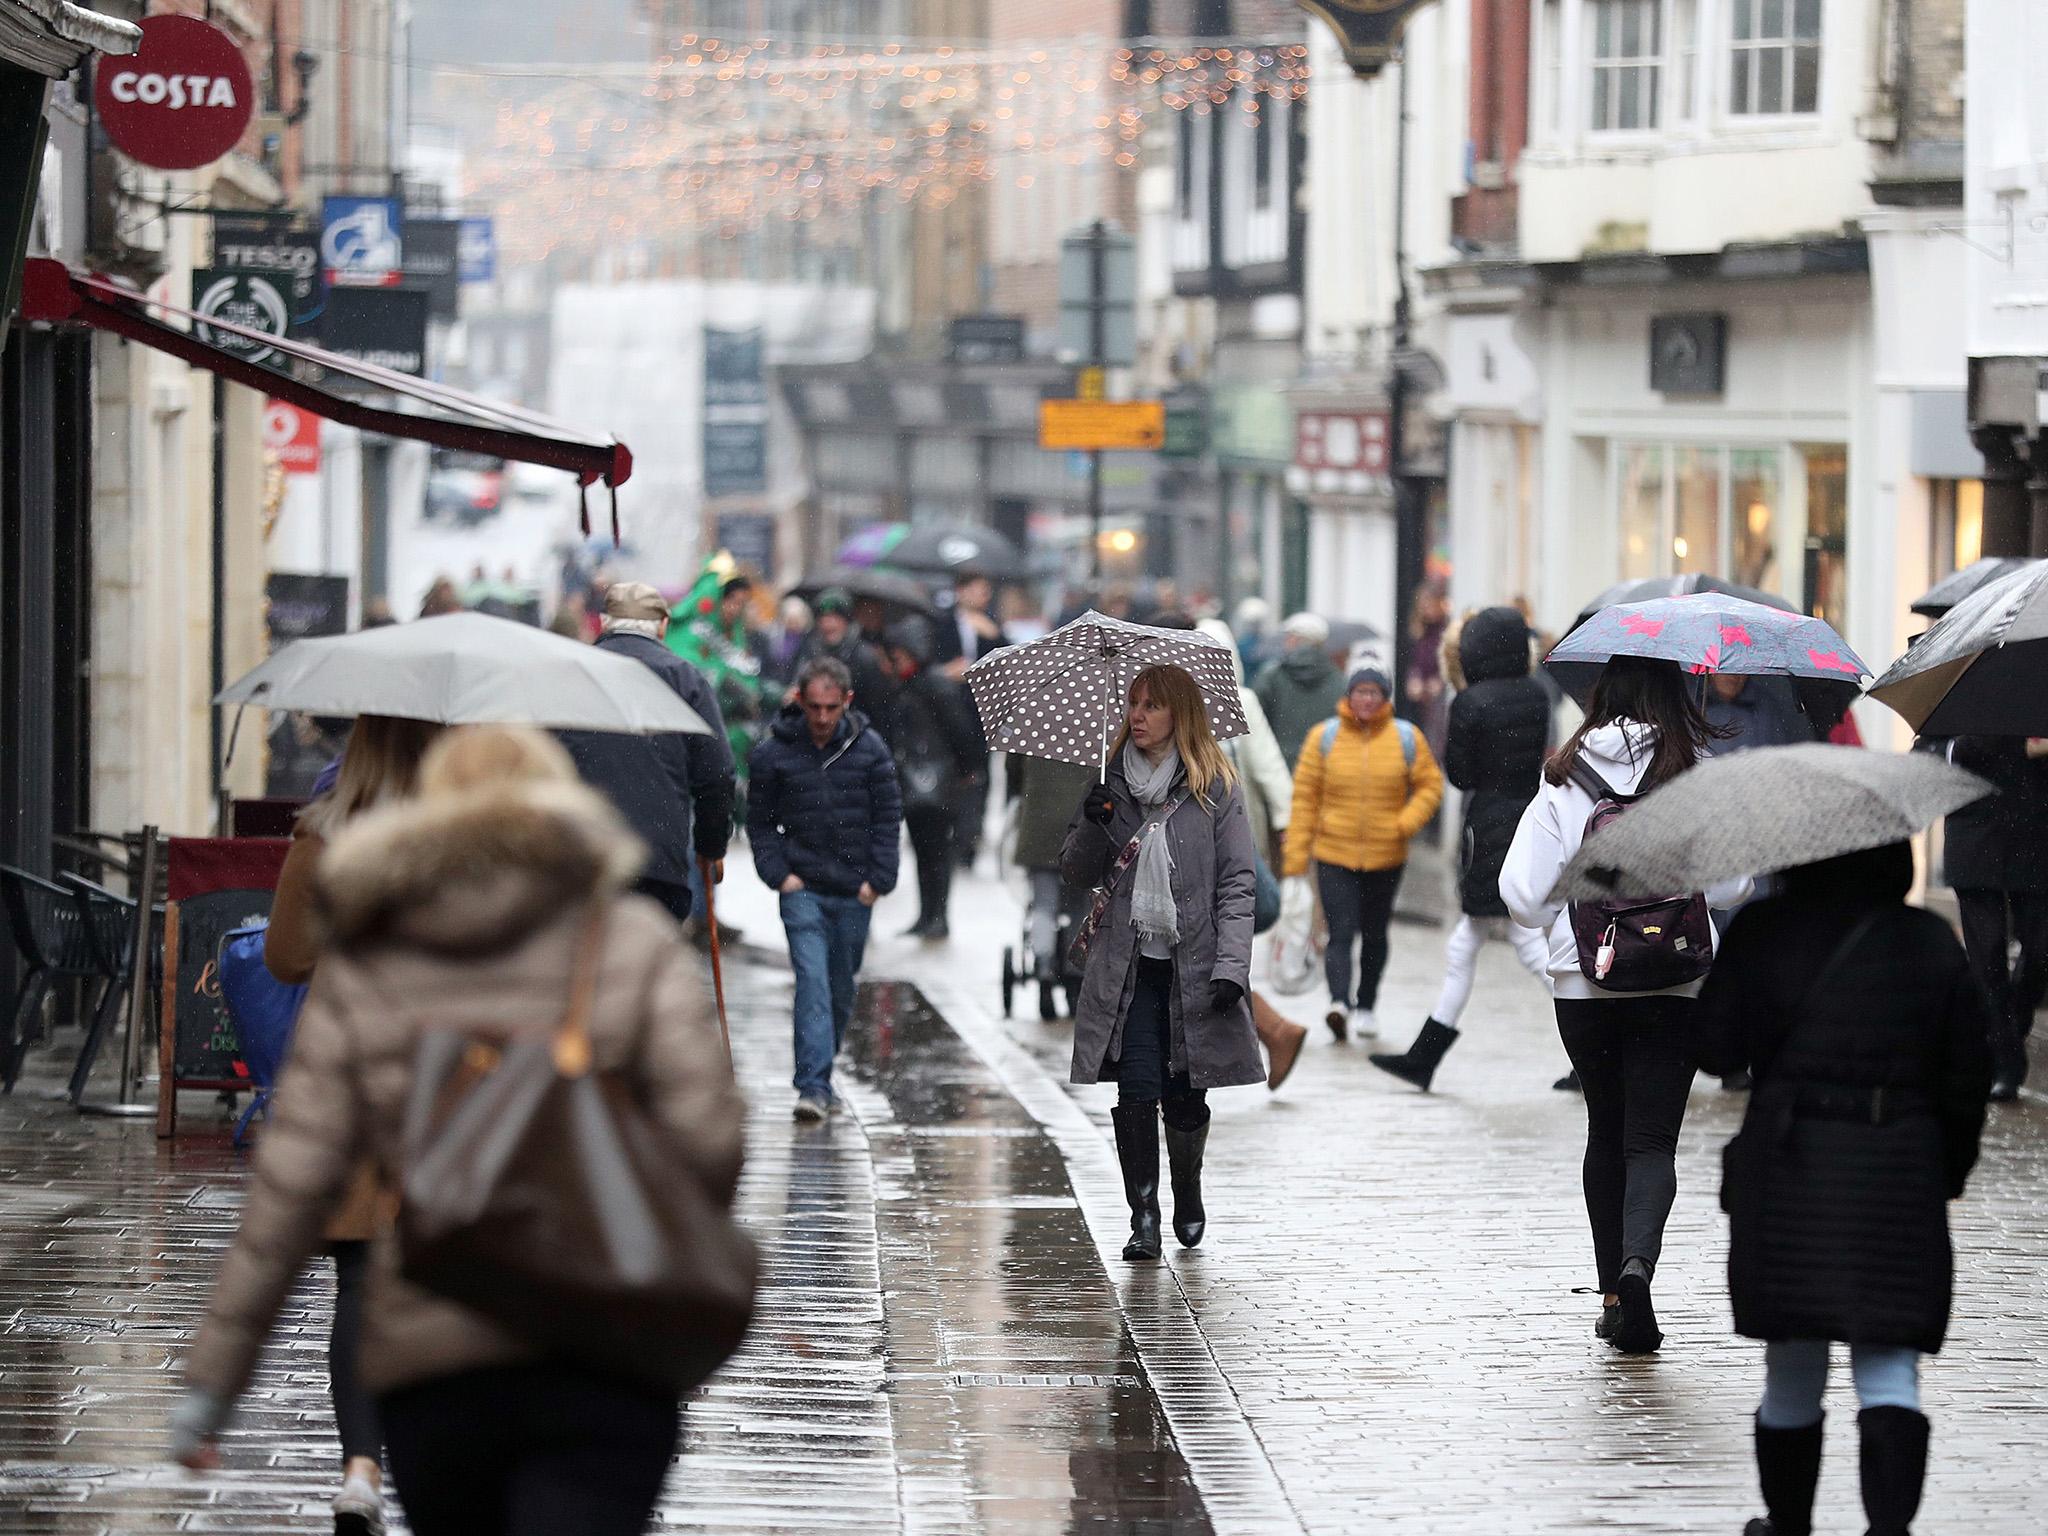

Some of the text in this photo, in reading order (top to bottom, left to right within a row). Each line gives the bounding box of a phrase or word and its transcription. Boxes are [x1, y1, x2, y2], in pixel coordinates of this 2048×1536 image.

[111, 71, 237, 110] COSTA
[219, 245, 318, 270] TESCO
[225, 302, 257, 319] THE
